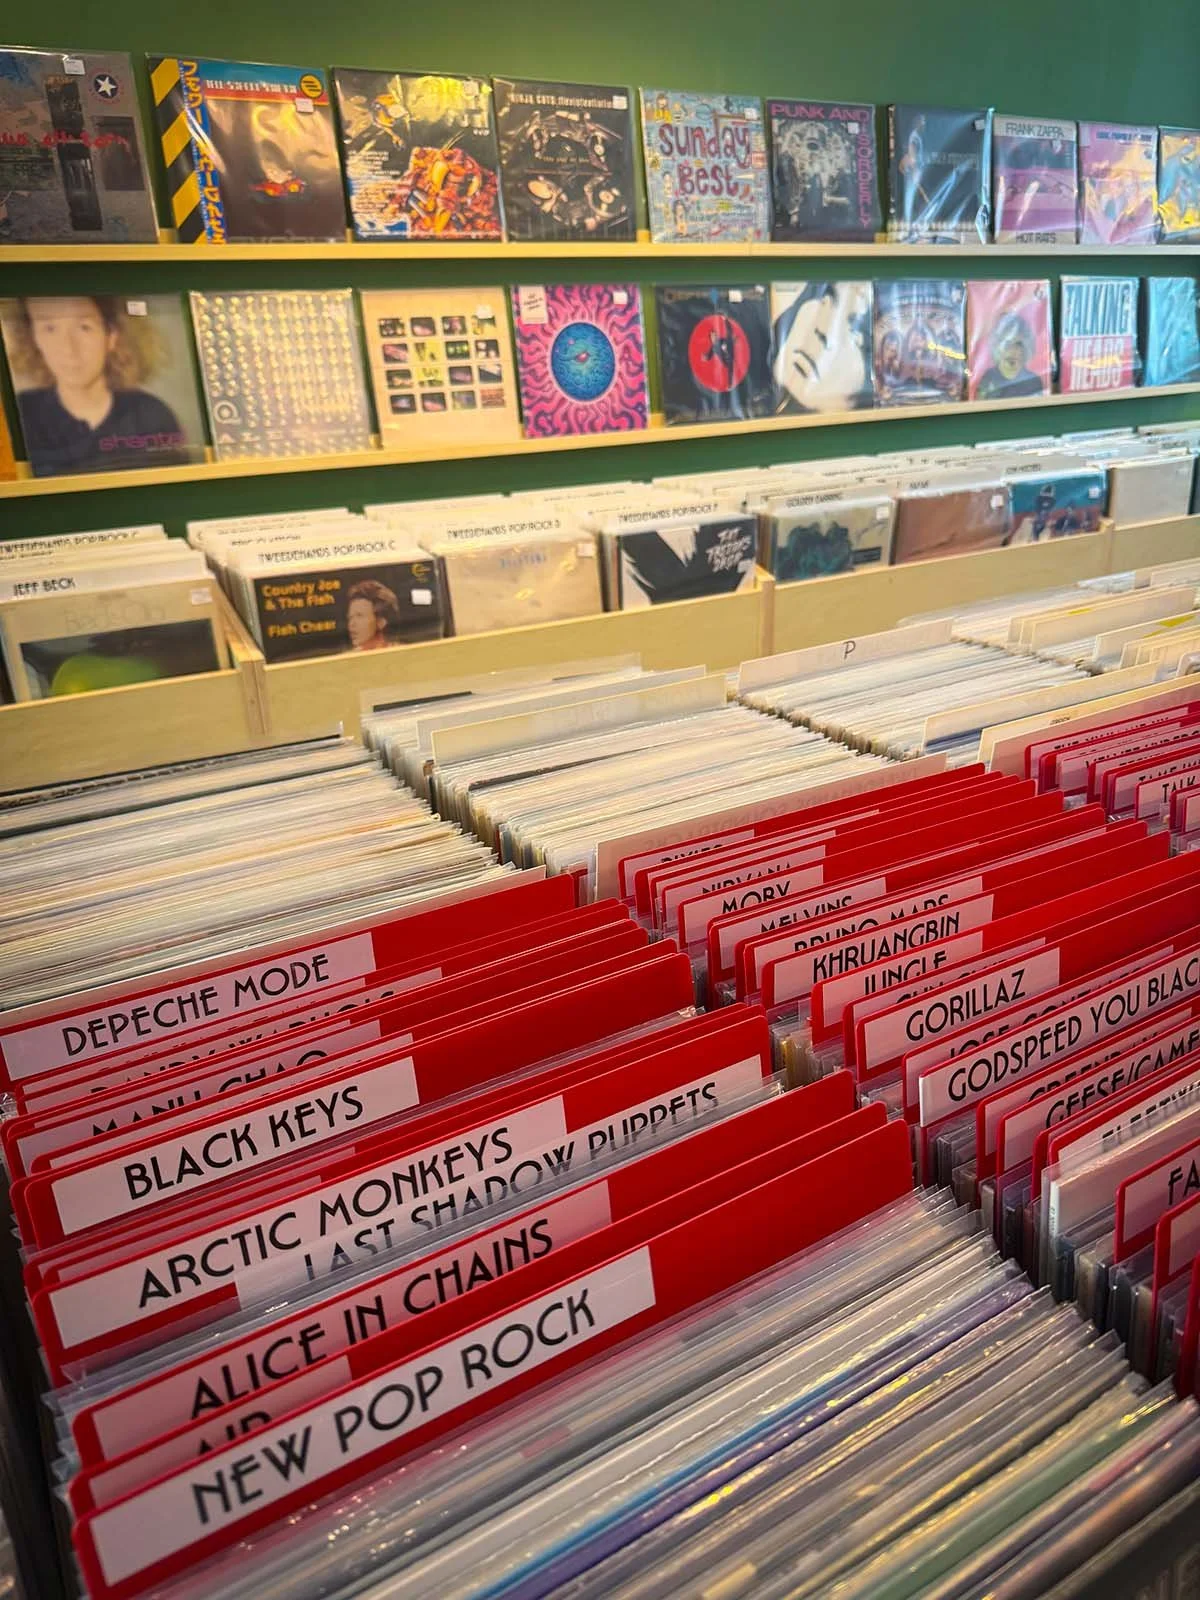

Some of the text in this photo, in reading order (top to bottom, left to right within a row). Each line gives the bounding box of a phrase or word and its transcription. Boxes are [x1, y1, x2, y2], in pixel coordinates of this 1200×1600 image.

[771, 103, 870, 122] PUNK AND
[1005, 122, 1065, 138] FRANK ZAPPA
[13, 577, 76, 597] JEFF BECK
[262, 579, 341, 599] Country Joe
[279, 596, 304, 610] The
[306, 594, 336, 607] Fish
[267, 619, 337, 638] Fish Cheer
[842, 640, 856, 660] P
[812, 911, 960, 984] KHRUANGBIN
[62, 986, 219, 1057] DEPECHE
[234, 953, 330, 1008] MODE
[906, 968, 1026, 1042] GORILLAZ
[948, 1015, 1082, 1102] GODSPEED
[1090, 991, 1141, 1034] YOU
[123, 1123, 259, 1200] BLACK
[268, 1085, 363, 1150] KEYS
[138, 1127, 513, 1310] ARCTIC MONKEYS
[304, 1218, 396, 1281] LAST
[410, 1140, 576, 1231] SHADOW
[191, 1217, 555, 1420] ALICE IN CHAINS
[191, 1425, 313, 1525] NEW
[333, 1364, 445, 1452] POP
[462, 1287, 597, 1389] ROCK
